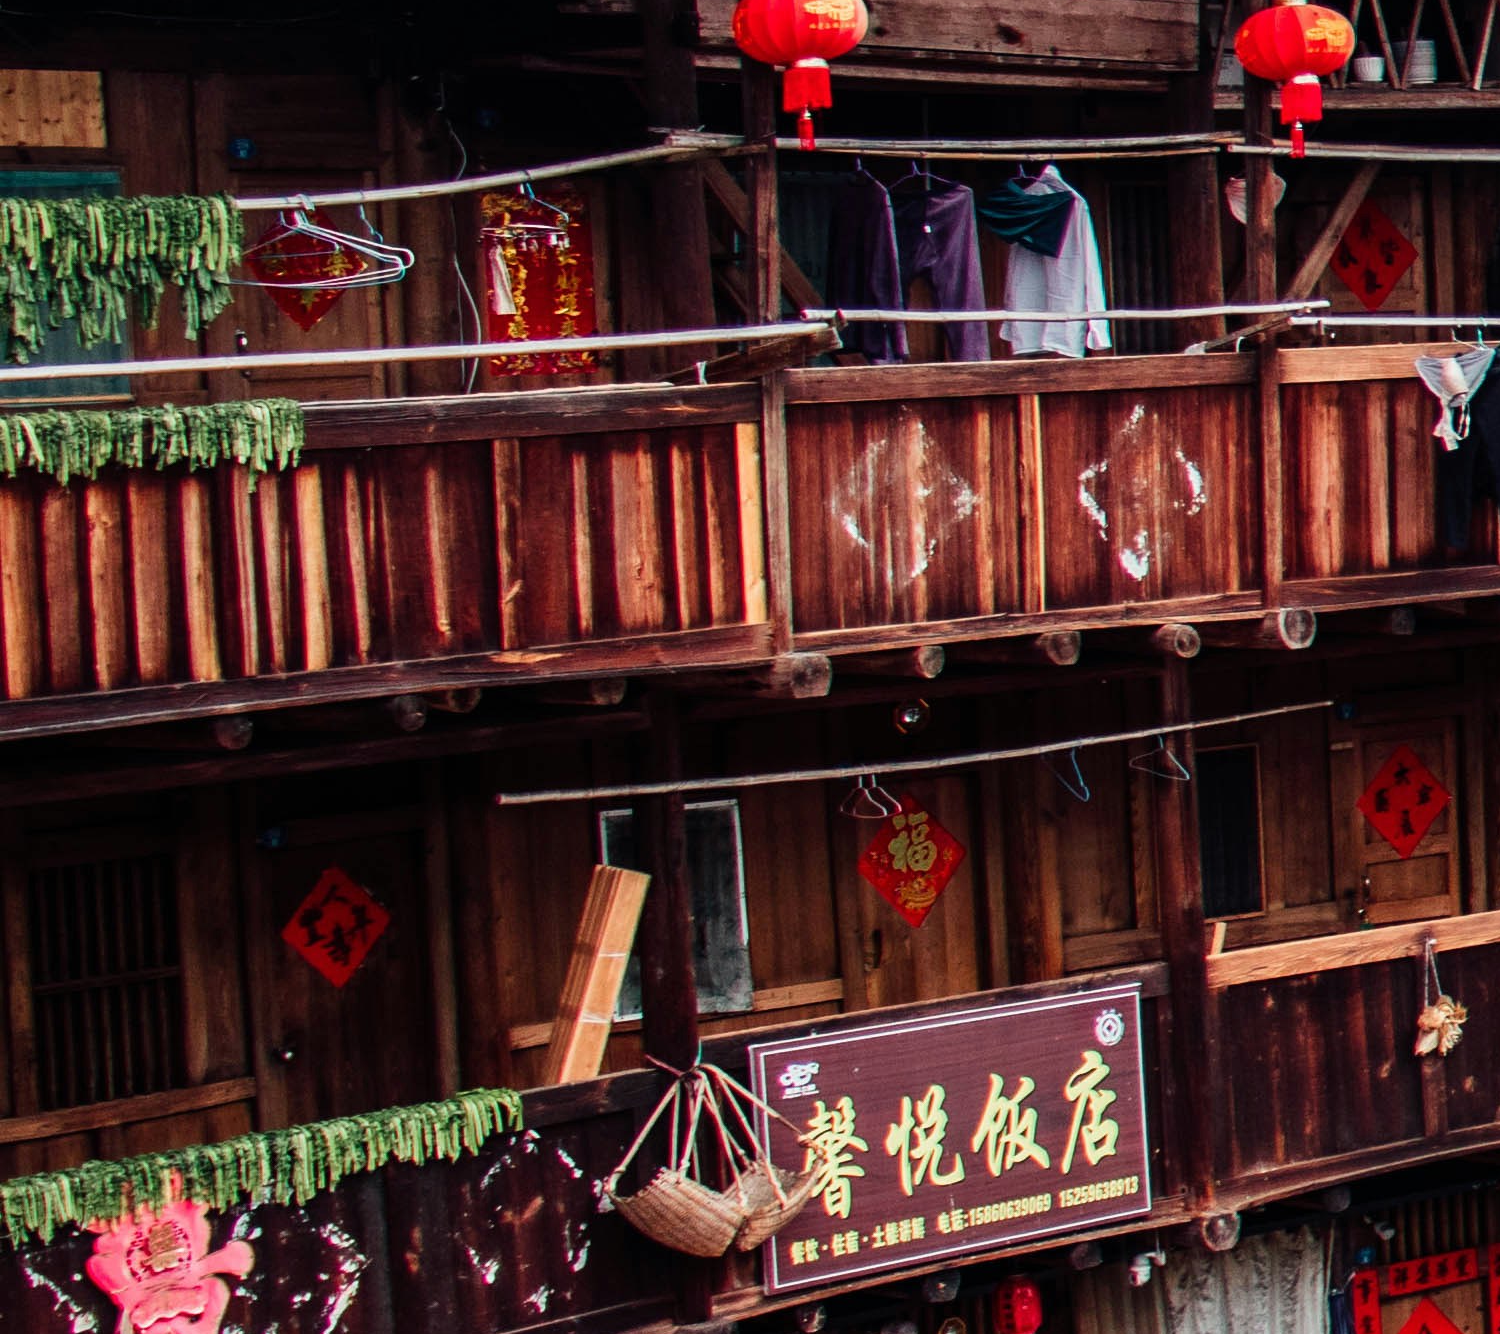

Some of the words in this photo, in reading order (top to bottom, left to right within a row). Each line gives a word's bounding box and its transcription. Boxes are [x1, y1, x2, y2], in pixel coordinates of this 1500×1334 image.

[888, 811, 938, 874] 福
[800, 1049, 1120, 1219] 馨悦饭店
